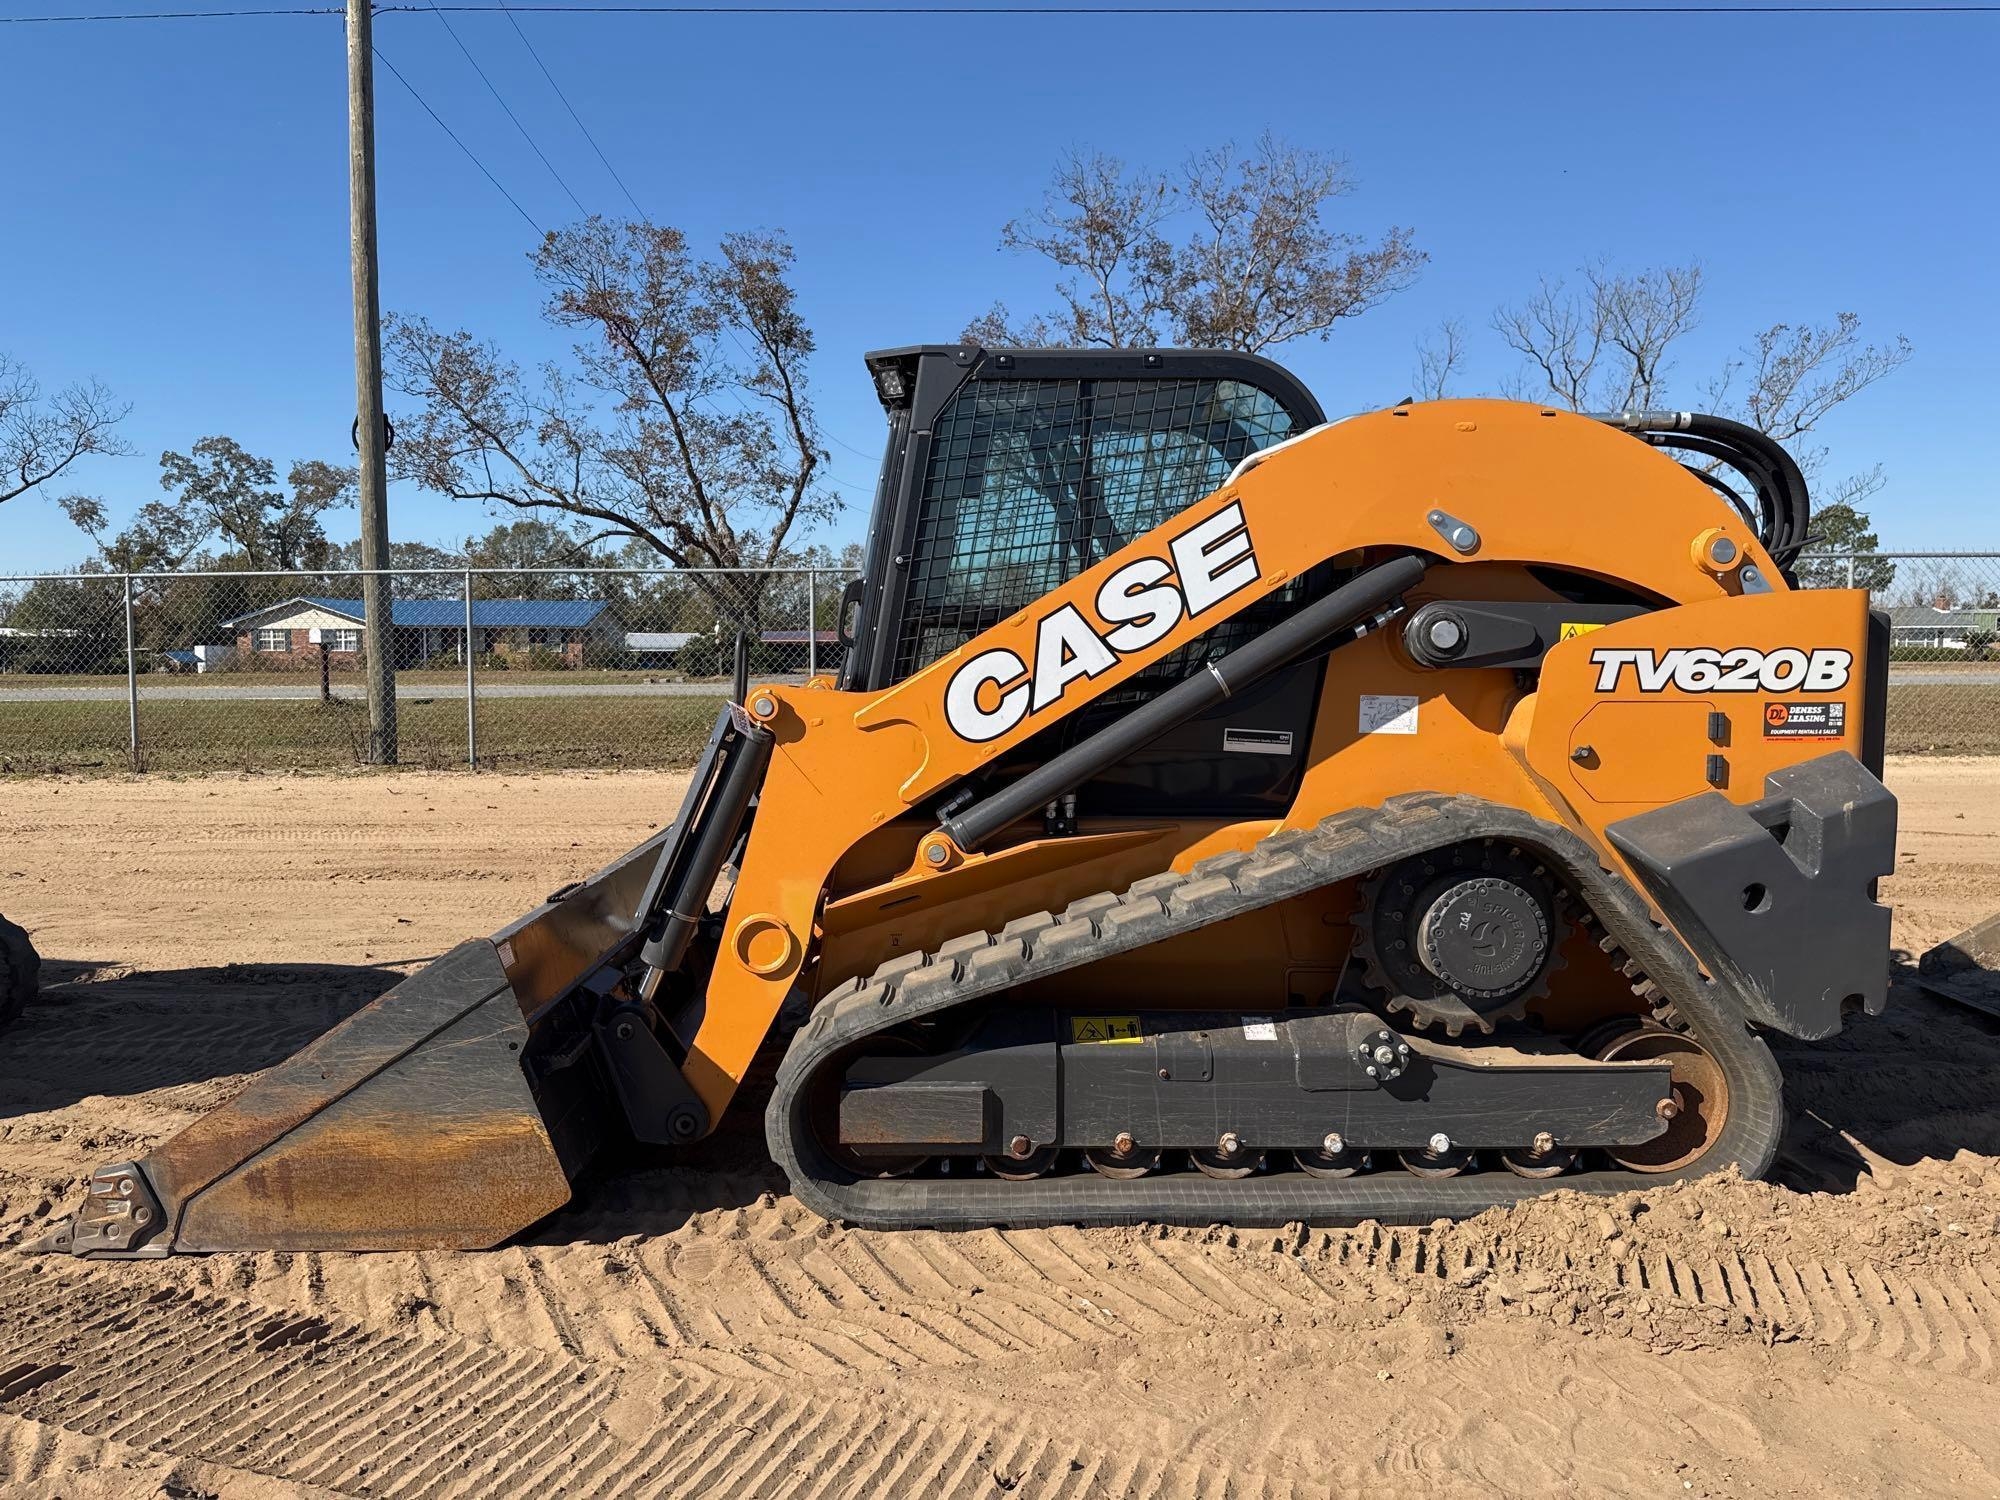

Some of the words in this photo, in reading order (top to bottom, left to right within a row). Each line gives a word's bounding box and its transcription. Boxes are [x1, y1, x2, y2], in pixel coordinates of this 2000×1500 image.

[944, 498, 1261, 743] CASE
[1589, 648, 1853, 693] TV620B
[1769, 708, 1785, 720] DL
[1787, 715, 1826, 723] LEASING
[1789, 706, 1823, 714] DENESS
[1482, 902, 1526, 938] SPICER
